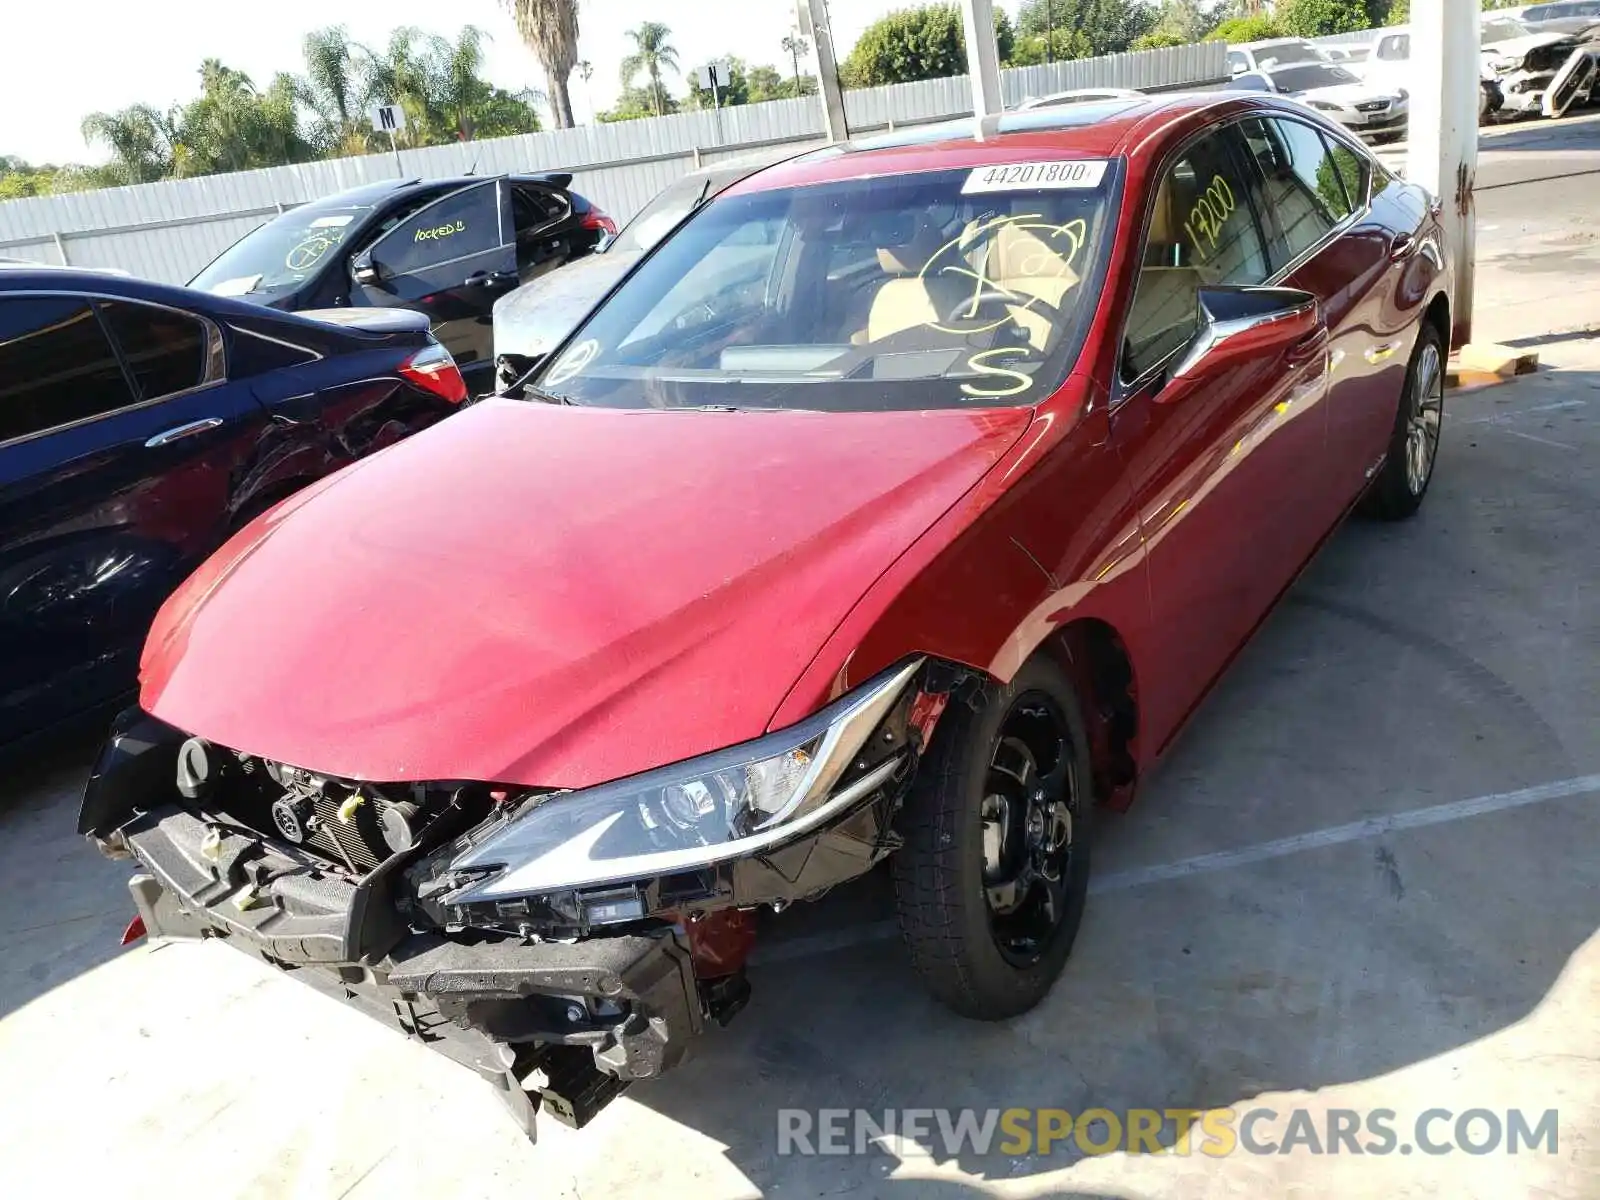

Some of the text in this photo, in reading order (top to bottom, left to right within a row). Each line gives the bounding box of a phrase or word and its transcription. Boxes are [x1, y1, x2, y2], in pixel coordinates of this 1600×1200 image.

[378, 107, 396, 130] M
[982, 163, 1086, 185] 44201800
[959, 347, 1033, 397] S
